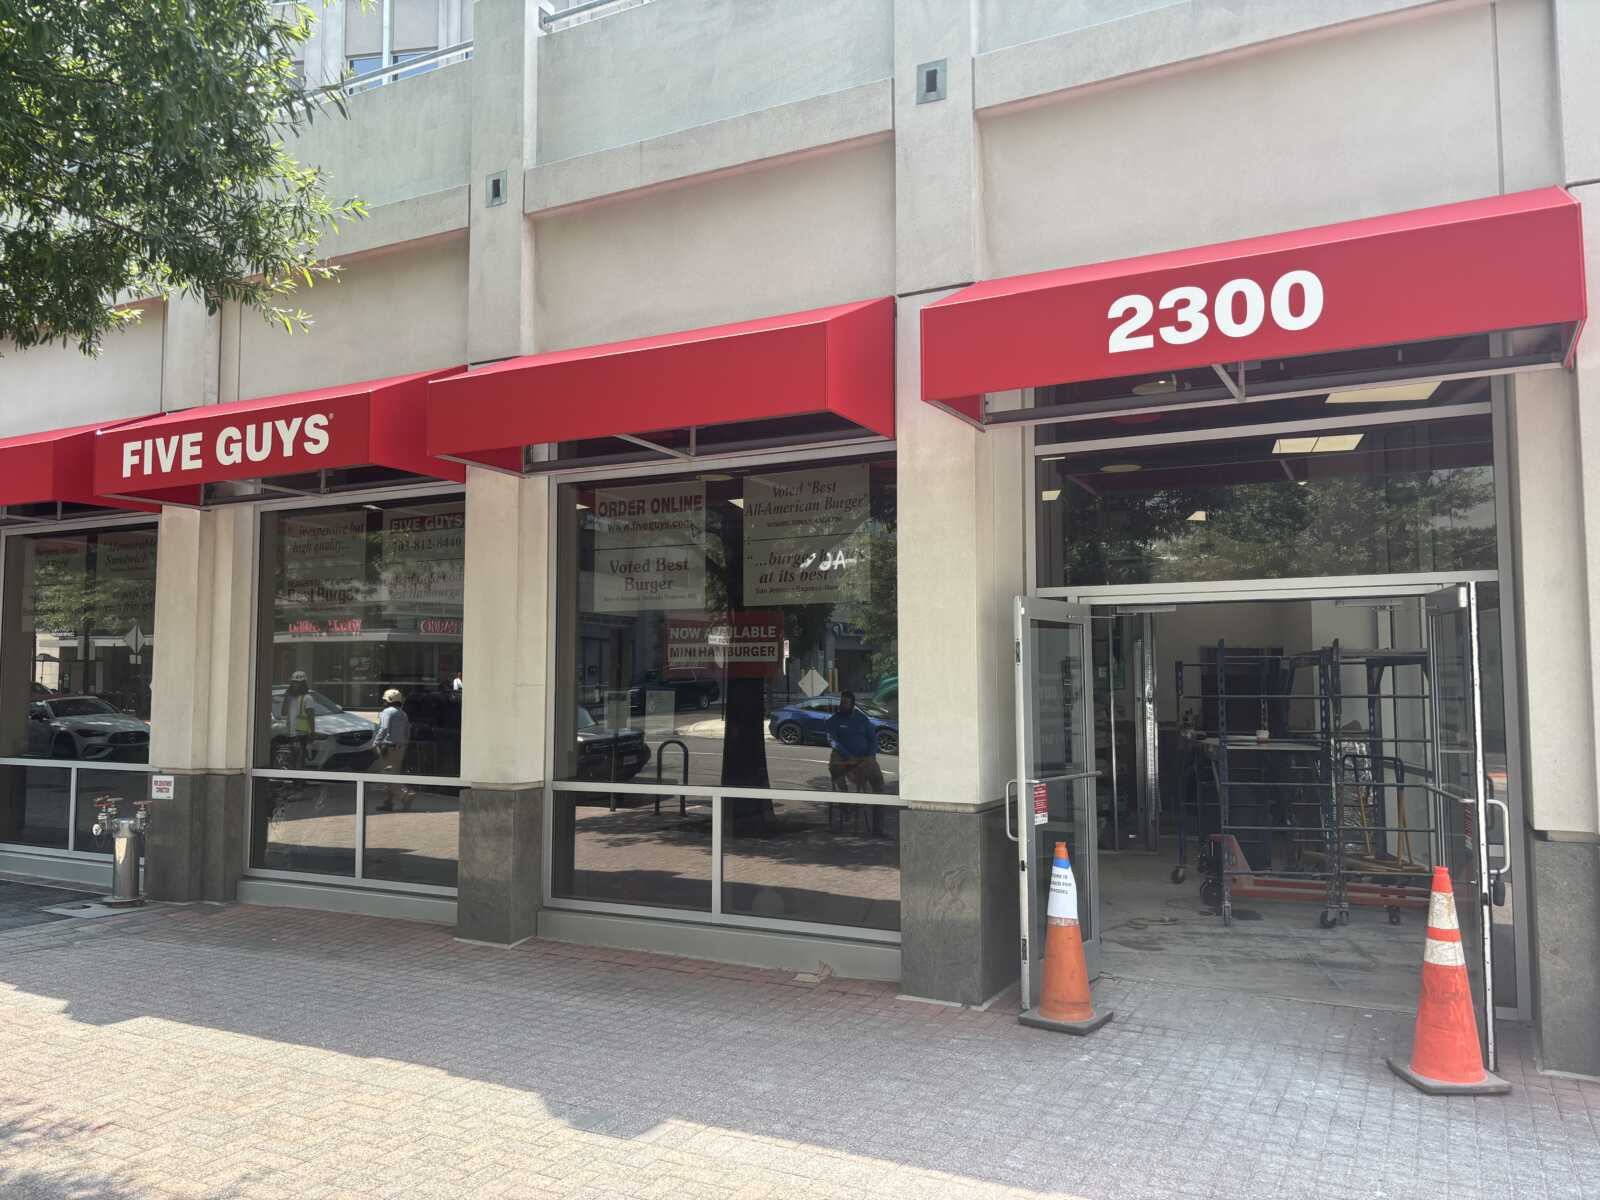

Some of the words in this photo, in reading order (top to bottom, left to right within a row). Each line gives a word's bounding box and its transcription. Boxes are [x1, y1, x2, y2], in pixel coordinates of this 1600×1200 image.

[1107, 270, 1324, 354] 2300
[122, 432, 203, 478] FIVE
[598, 500, 646, 518] ORDER
[650, 495, 703, 514] ONLINE
[610, 559, 651, 574] Voted
[655, 557, 689, 572] Best
[624, 577, 673, 593] Burger
[670, 627, 700, 640] NOW
[704, 626, 777, 640] AILABLE
[670, 647, 697, 657] MINI
